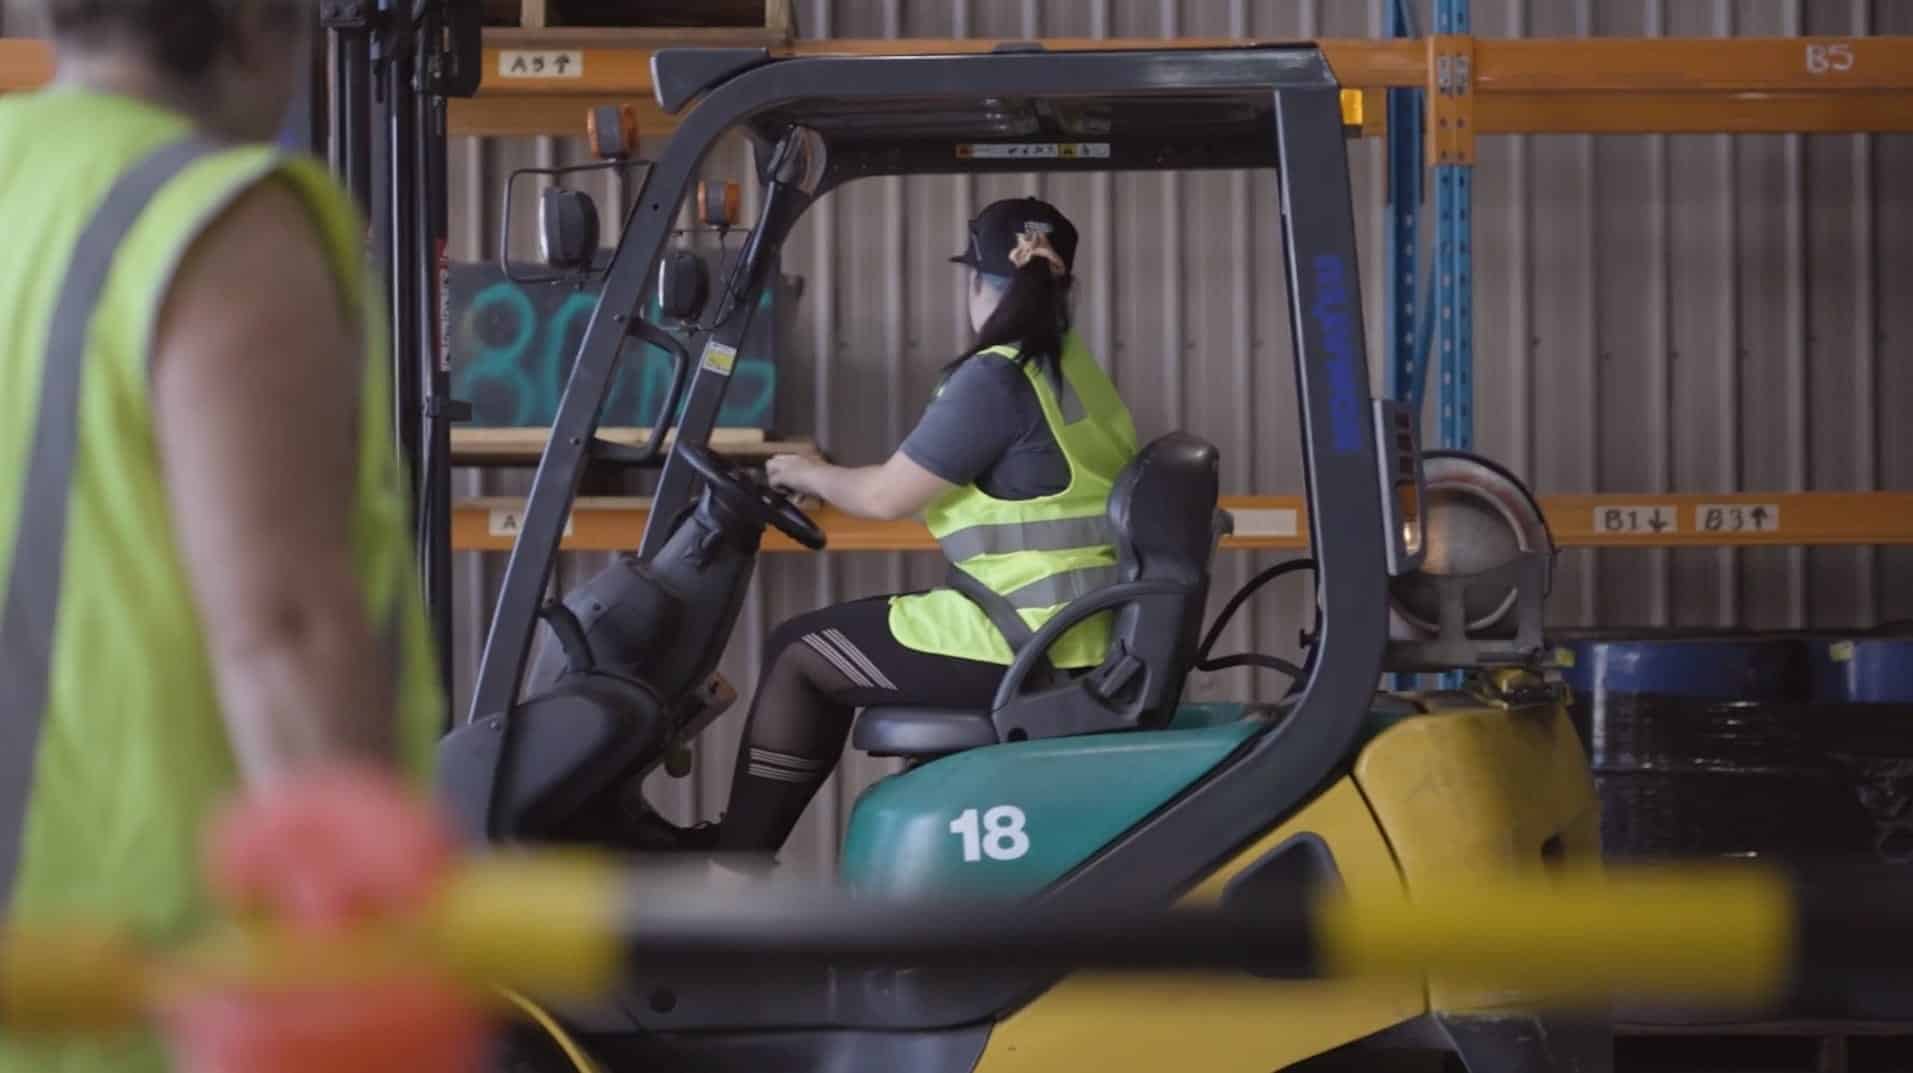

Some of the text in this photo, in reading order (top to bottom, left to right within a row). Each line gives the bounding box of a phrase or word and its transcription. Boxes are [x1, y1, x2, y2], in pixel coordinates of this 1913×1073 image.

[1805, 45, 1855, 73] B5
[1604, 508, 1638, 530] B1
[949, 804, 1030, 862] 18
